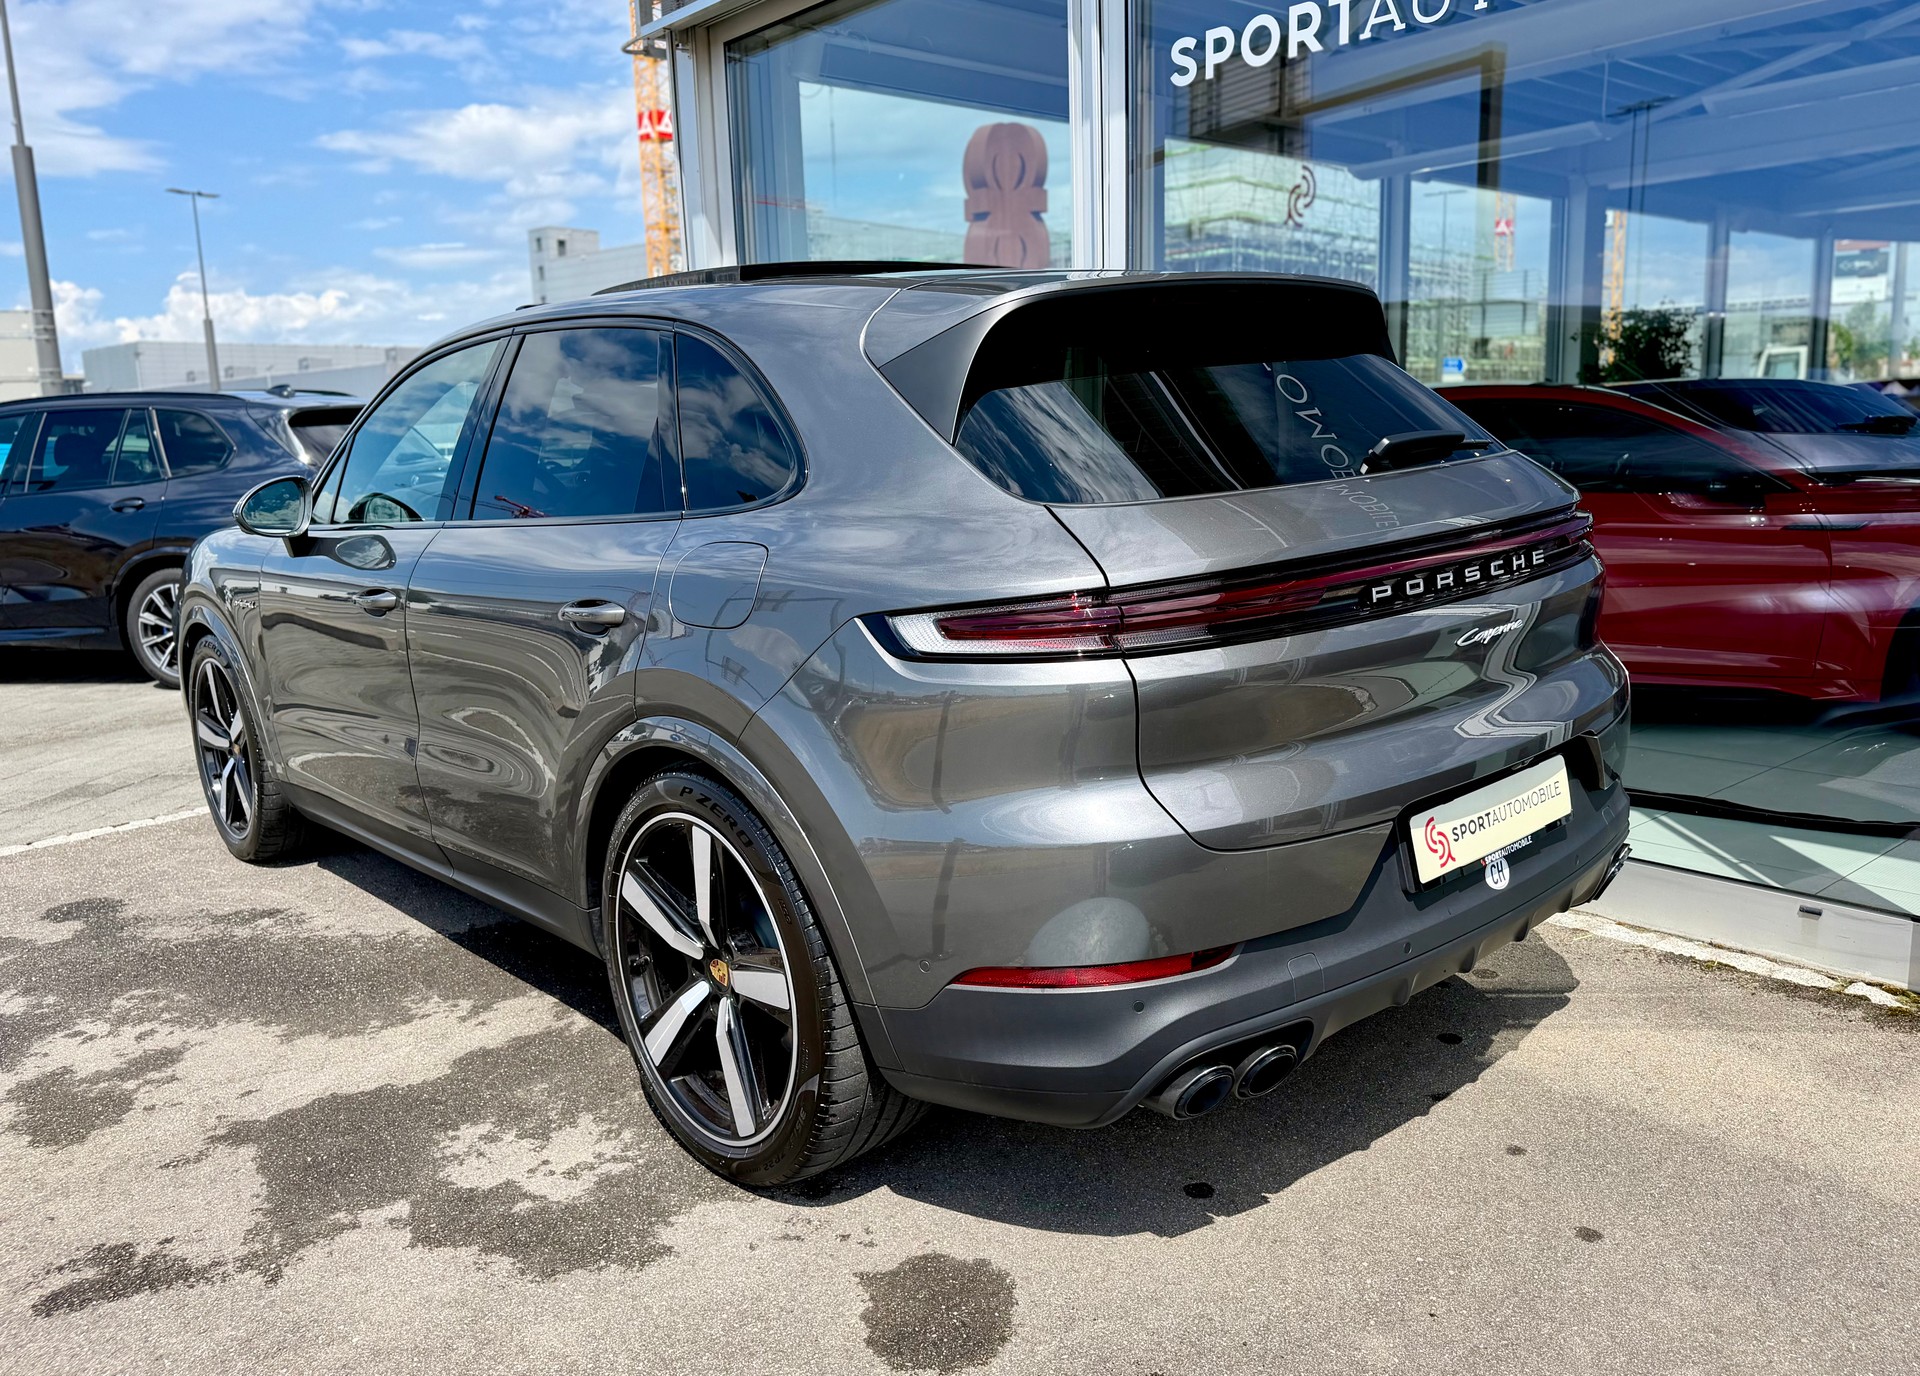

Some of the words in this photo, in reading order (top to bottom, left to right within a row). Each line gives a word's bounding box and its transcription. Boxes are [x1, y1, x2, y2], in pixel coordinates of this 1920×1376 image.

[1169, 0, 1488, 87] SPORTAU
[1371, 549, 1545, 603] PORSCHE
[203, 640, 222, 657] ZERO
[1454, 618, 1524, 647] Cayenne
[679, 786, 694, 797] P
[695, 793, 755, 849] ZERO
[1451, 780, 1562, 842] SPORTAUTOMOBILE
[1484, 835, 1533, 865] SPORTAUTOMOBILE
[1490, 860, 1506, 885] CH
